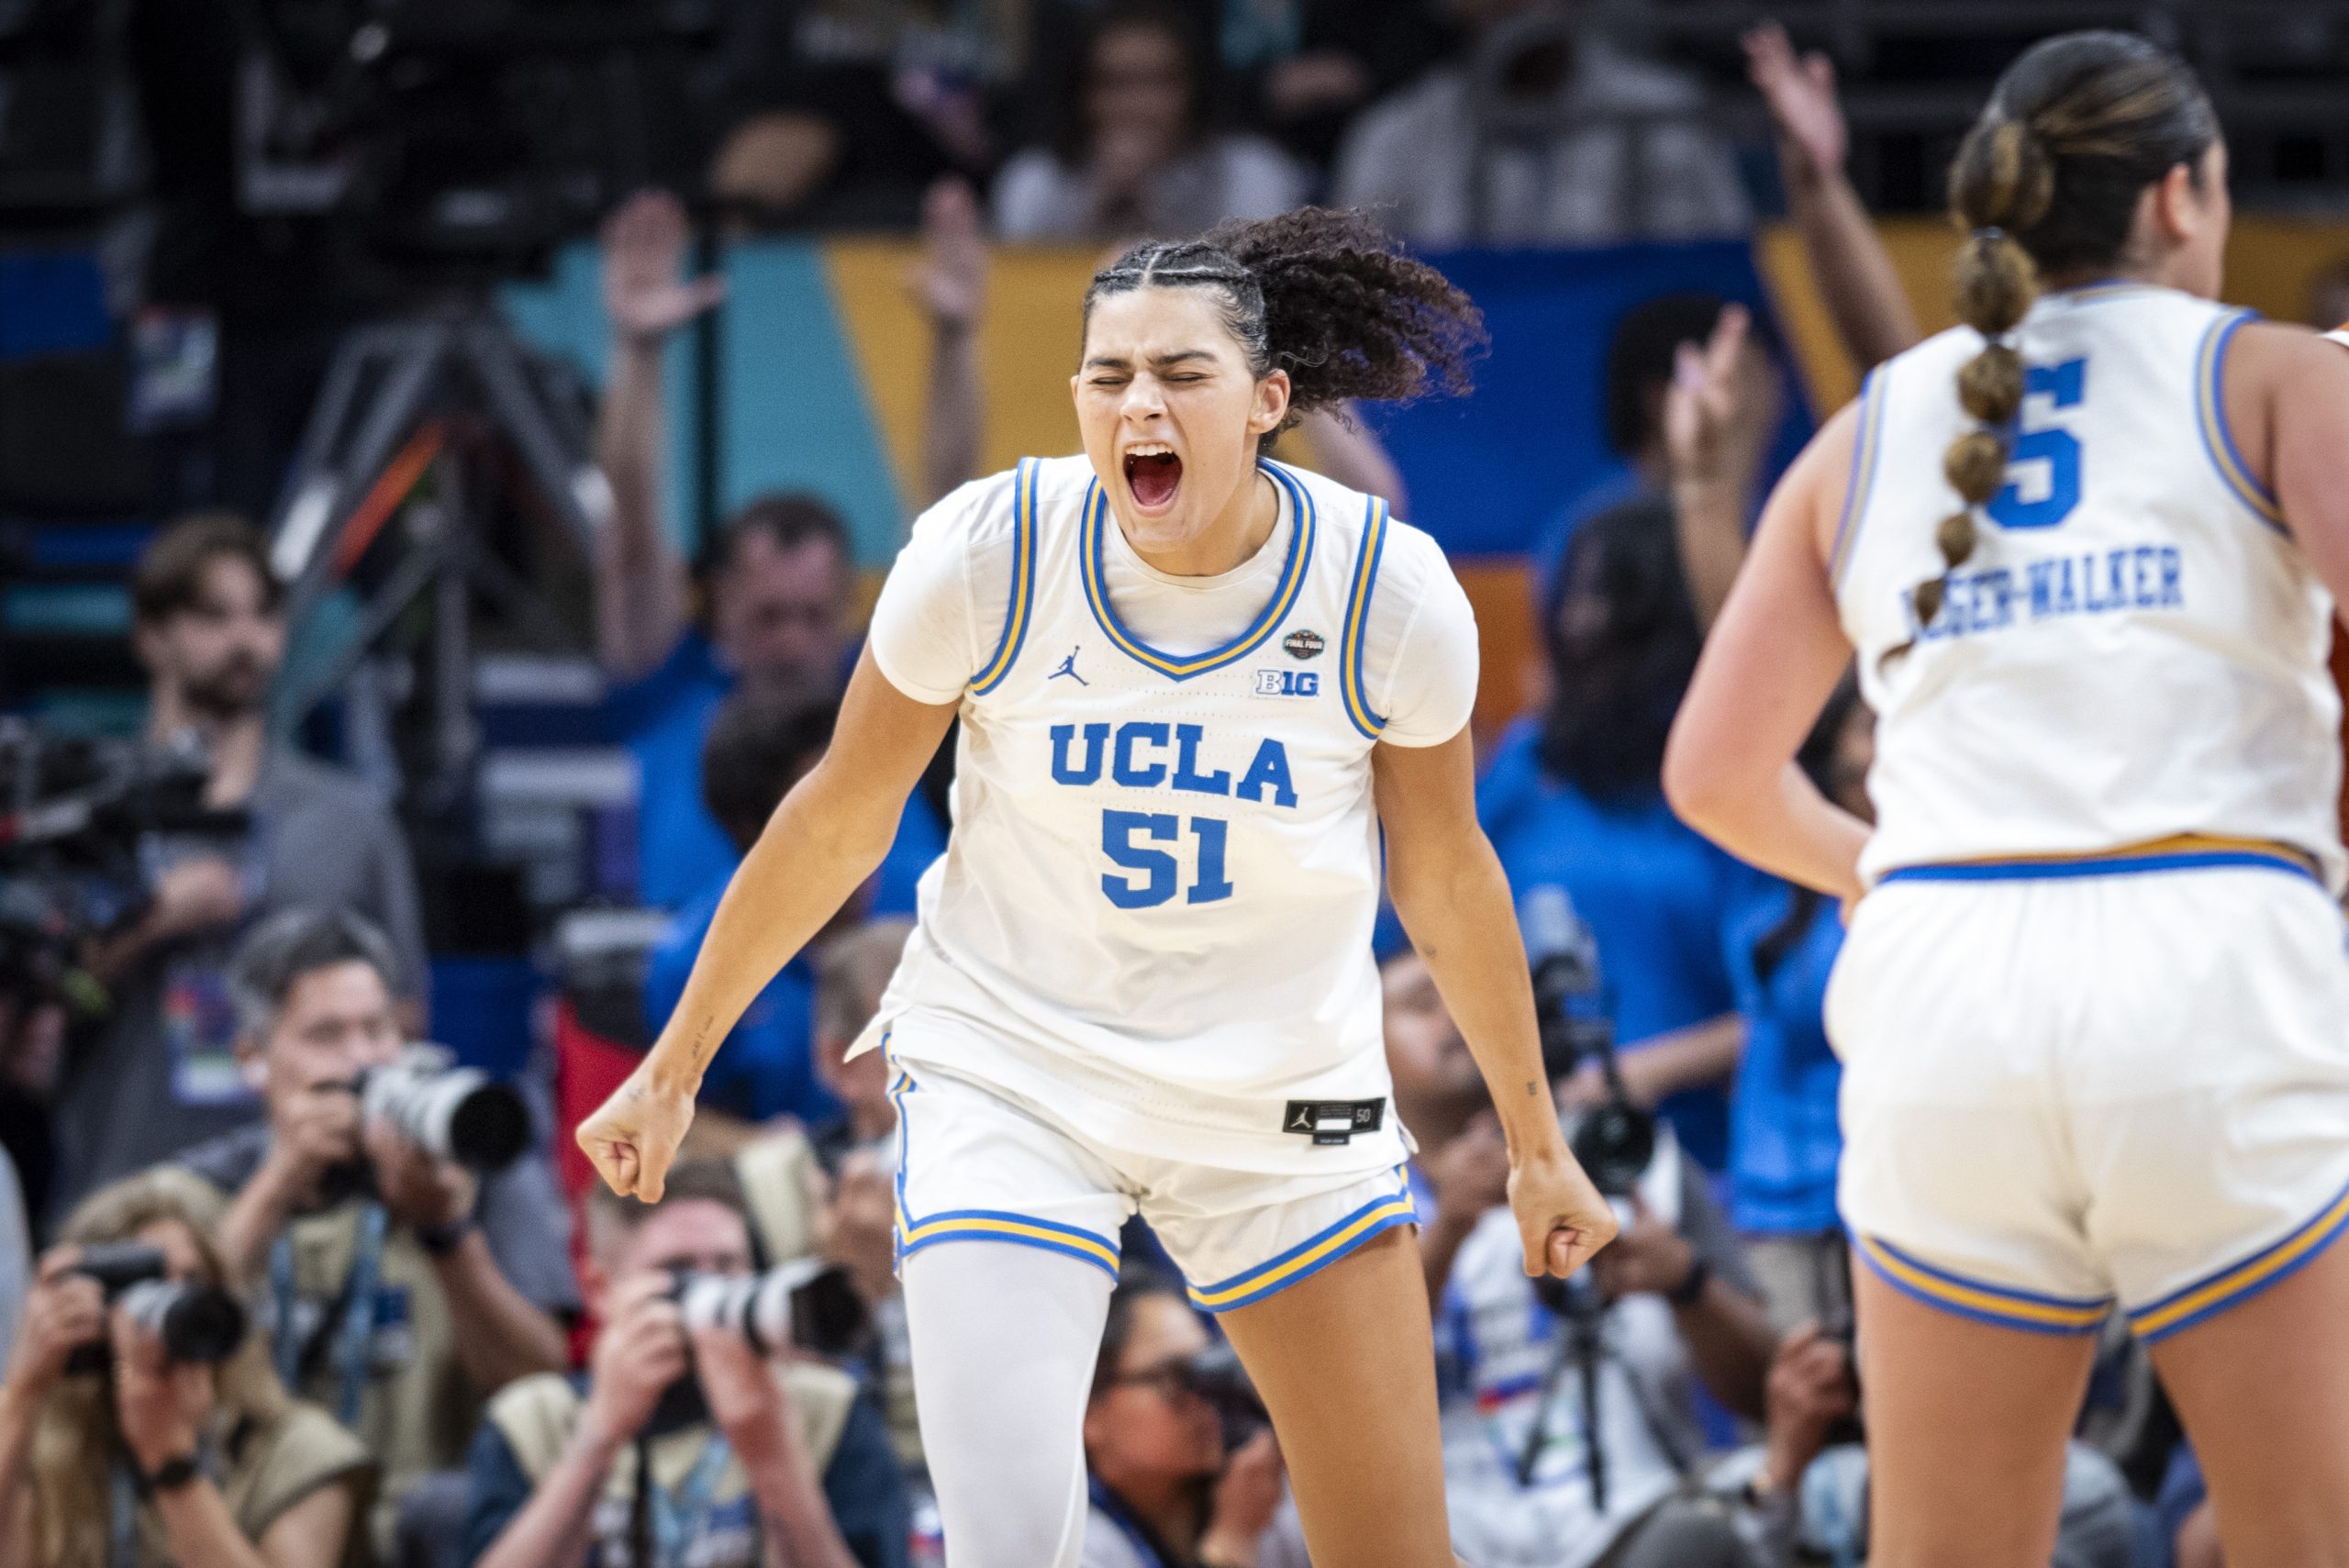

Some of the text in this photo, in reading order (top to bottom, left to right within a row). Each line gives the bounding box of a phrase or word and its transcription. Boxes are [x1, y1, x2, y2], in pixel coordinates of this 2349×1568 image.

[1986, 356, 2087, 529] 5
[1900, 547, 2184, 640] GER-WALKER
[1050, 722, 1298, 808] UCLA
[1102, 808, 1233, 909] 51
[1356, 1108, 1372, 1123] 50
